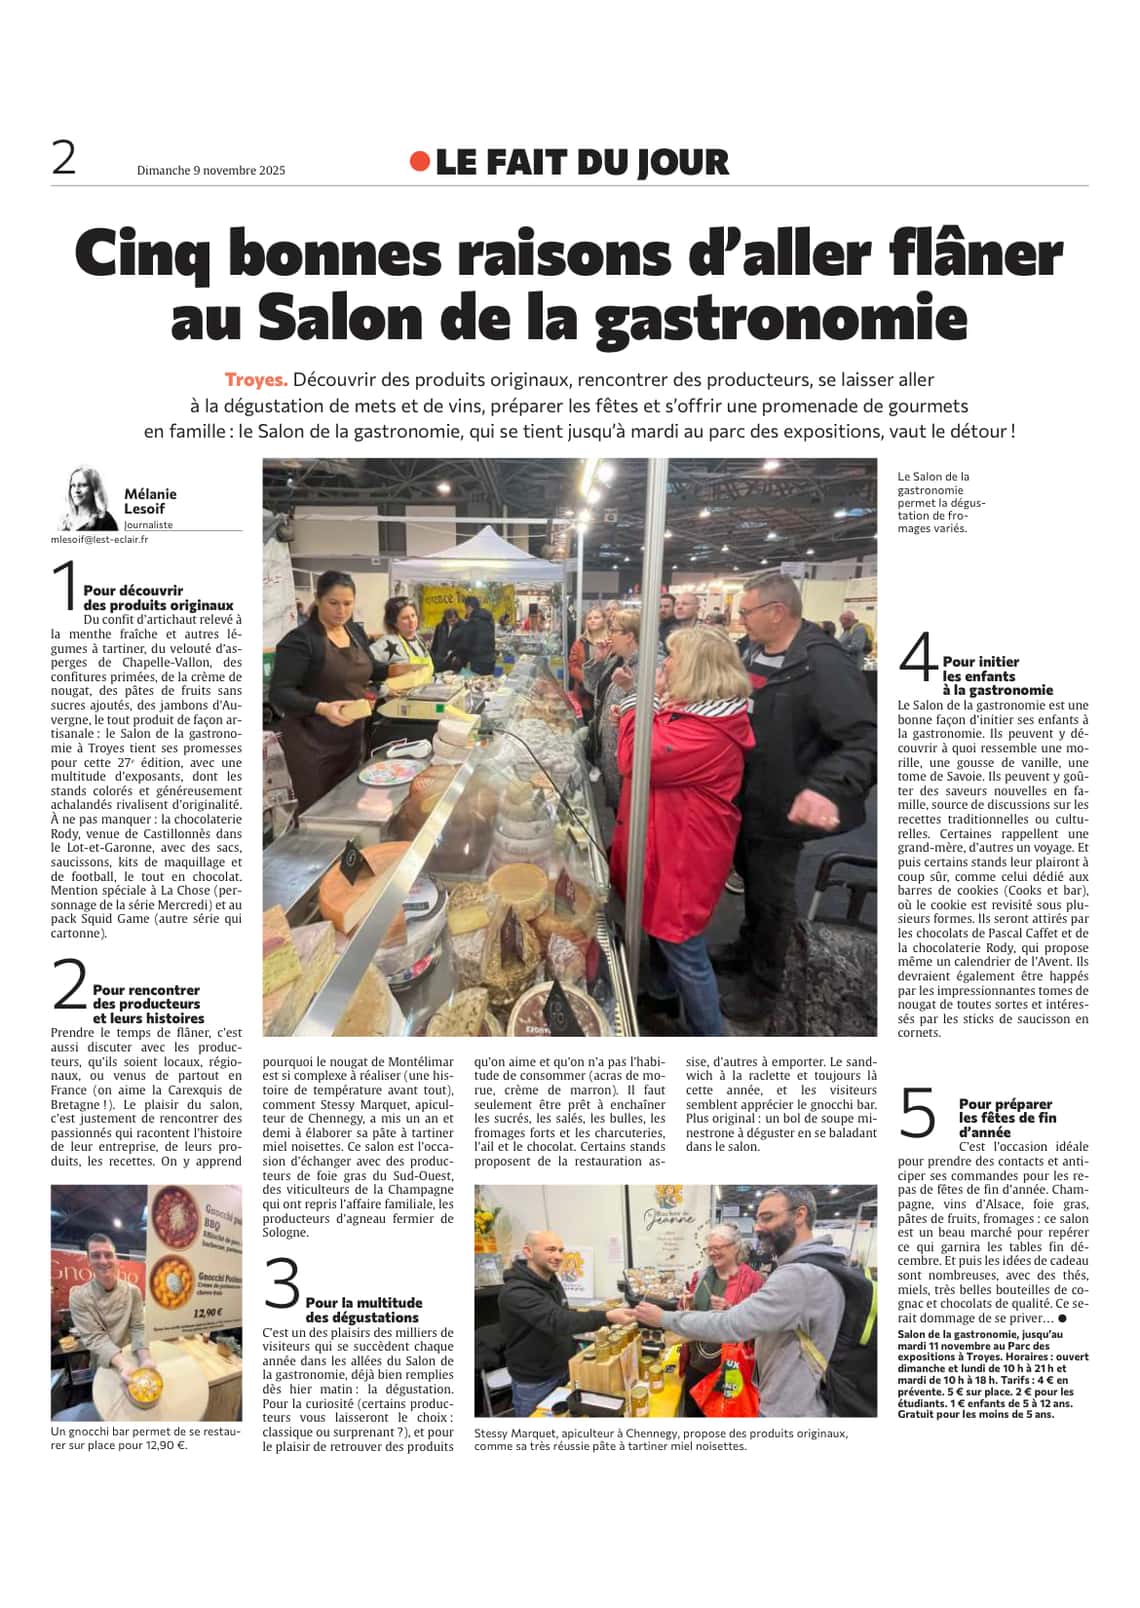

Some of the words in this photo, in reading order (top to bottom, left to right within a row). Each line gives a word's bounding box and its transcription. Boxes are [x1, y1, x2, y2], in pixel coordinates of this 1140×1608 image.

[53, 139, 75, 174] 2
[138, 165, 190, 175] Dimanche
[194, 166, 200, 175] 9
[204, 165, 256, 175] novembre
[260, 166, 285, 175] 2025
[437, 148, 477, 175] LE
[488, 148, 568, 175] FAIT
[578, 149, 628, 175] DU
[637, 148, 730, 181] JOUR
[75, 226, 210, 288] Cinq
[230, 226, 442, 276] bonnes
[459, 226, 672, 276] raisons
[689, 226, 872, 276] d’aller
[889, 225, 1064, 276] flâner
[171, 306, 240, 340] au
[259, 290, 422, 341] Salon
[440, 290, 511, 340] de
[528, 290, 577, 340] la
[595, 290, 968, 353] gastronomie
[225, 372, 288, 390] Troyes.
[294, 371, 376, 386] Découvrir
[382, 372, 410, 386] des
[416, 372, 485, 390] produits
[491, 372, 572, 390] originaux,
[579, 373, 668, 387] rencontrer
[673, 372, 701, 386] des
[708, 372, 813, 390] producteurs,
[819, 376, 836, 386] se
[842, 372, 894, 386] laisser
[899, 371, 935, 386] aller
[898, 472, 910, 481] Le
[913, 472, 942, 481] Salon
[946, 472, 957, 481] de
[961, 472, 969, 481] la
[125, 488, 176, 499] Mélanie
[898, 486, 963, 497] gastronomie
[125, 503, 165, 514] Lesoif
[898, 499, 936, 509] permet
[939, 498, 947, 507] la
[951, 498, 986, 509] dégus-
[898, 511, 929, 520] tation
[933, 511, 944, 520] de
[949, 511, 968, 520] fro-
[124, 521, 173, 530] Journaliste
[898, 526, 930, 534] mages
[934, 523, 967, 533] variés.
[51, 535, 148, 544] mlesoif@lest-eclair.fr
[53, 560, 73, 610] 1
[84, 585, 116, 596] Pour
[120, 584, 183, 596] découvrir
[84, 599, 106, 611] des
[110, 599, 166, 613] produits
[170, 599, 234, 613] originaux
[899, 632, 939, 681] 4
[943, 656, 975, 667] Pour
[979, 656, 1020, 667] initier
[943, 670, 961, 682] les
[965, 670, 1016, 682] enfants
[51, 687, 92, 698] nougat,
[99, 685, 117, 695] des
[125, 685, 154, 698] pâtes
[161, 685, 174, 695] de
[182, 685, 211, 695] fruits
[943, 683, 950, 695] à
[954, 684, 965, 695] la
[969, 684, 1053, 698] gastronomie
[54, 958, 87, 1009] 2
[93, 984, 125, 995] Pour
[129, 985, 200, 995] rencontrer
[898, 988, 916, 998] par
[920, 985, 934, 995] les
[938, 985, 1035, 998] impressionnantes
[1039, 987, 1072, 995] tomes
[1076, 985, 1088, 995] de
[93, 998, 115, 1009] des
[120, 998, 200, 1011] producteurs
[93, 1013, 107, 1024] et
[110, 1012, 142, 1024] leurs
[146, 1012, 204, 1024] histoires
[263, 1085, 288, 1095] toire
[294, 1085, 307, 1095] de
[314, 1085, 382, 1097] température
[388, 1086, 417, 1095] avant
[424, 1085, 453, 1096] tout),
[474, 1099, 532, 1109] seulement
[539, 1099, 561, 1109] être
[568, 1099, 590, 1112] prêt
[598, 1099, 603, 1109] à
[611, 1099, 665, 1109] enchaîner
[686, 1099, 738, 1109] semblent
[741, 1099, 793, 1112] apprécier
[798, 1099, 807, 1109] le
[810, 1099, 853, 1112] gnocchi
[857, 1099, 877, 1109] bar.
[960, 1098, 991, 1109] Pour
[995, 1097, 1053, 1111] préparer
[901, 1088, 935, 1138] 5
[960, 1112, 978, 1123] les
[981, 1111, 1015, 1123] fêtes
[1017, 1111, 1035, 1123] de
[1038, 1112, 1056, 1123] fin
[205, 1204, 233, 1223] Gnocchi
[204, 1217, 221, 1232] BBQ
[643, 1208, 697, 1232] Jeanne
[198, 1271, 224, 1282] Gnocchi
[265, 1257, 299, 1309] 3
[306, 1297, 338, 1308] Pour
[342, 1297, 353, 1308] la
[357, 1297, 423, 1308] multitude
[194, 1308, 216, 1319] 12,90
[217, 1307, 223, 1317] €
[306, 1312, 328, 1323] des
[332, 1311, 419, 1326] dégustations
[898, 1342, 926, 1350] mardi
[929, 1342, 938, 1350] 11
[941, 1342, 991, 1350] novembre
[1008, 1342, 1030, 1350] Parc
[1033, 1341, 1050, 1350] des
[51, 1427, 65, 1436] Un
[69, 1427, 109, 1438] gnocchi
[113, 1426, 129, 1436] bar
[133, 1428, 170, 1438] permet
[174, 1427, 186, 1436] de
[204, 1427, 240, 1436] restau-
[475, 1429, 507, 1440] Stessy
[511, 1429, 558, 1440] Marquet,
[562, 1429, 614, 1440] apiculteur
[617, 1429, 623, 1438] à
[626, 1429, 680, 1440] Chennegy,
[684, 1431, 726, 1440] propose
[729, 1429, 746, 1438] des
[750, 1429, 793, 1440] produits
[797, 1429, 848, 1440] originaux,
[88, 1441, 115, 1452] place
[119, 1443, 143, 1451] pour
[146, 1441, 174, 1451] 12,90
[177, 1441, 187, 1449] €.
[530, 1441, 550, 1450] très
[554, 1441, 590, 1450] réussie
[593, 1441, 616, 1452] pâte
[619, 1441, 625, 1450] à
[628, 1441, 667, 1450] tartiner
[671, 1441, 692, 1450] miel
[696, 1442, 747, 1450] noisettes.
